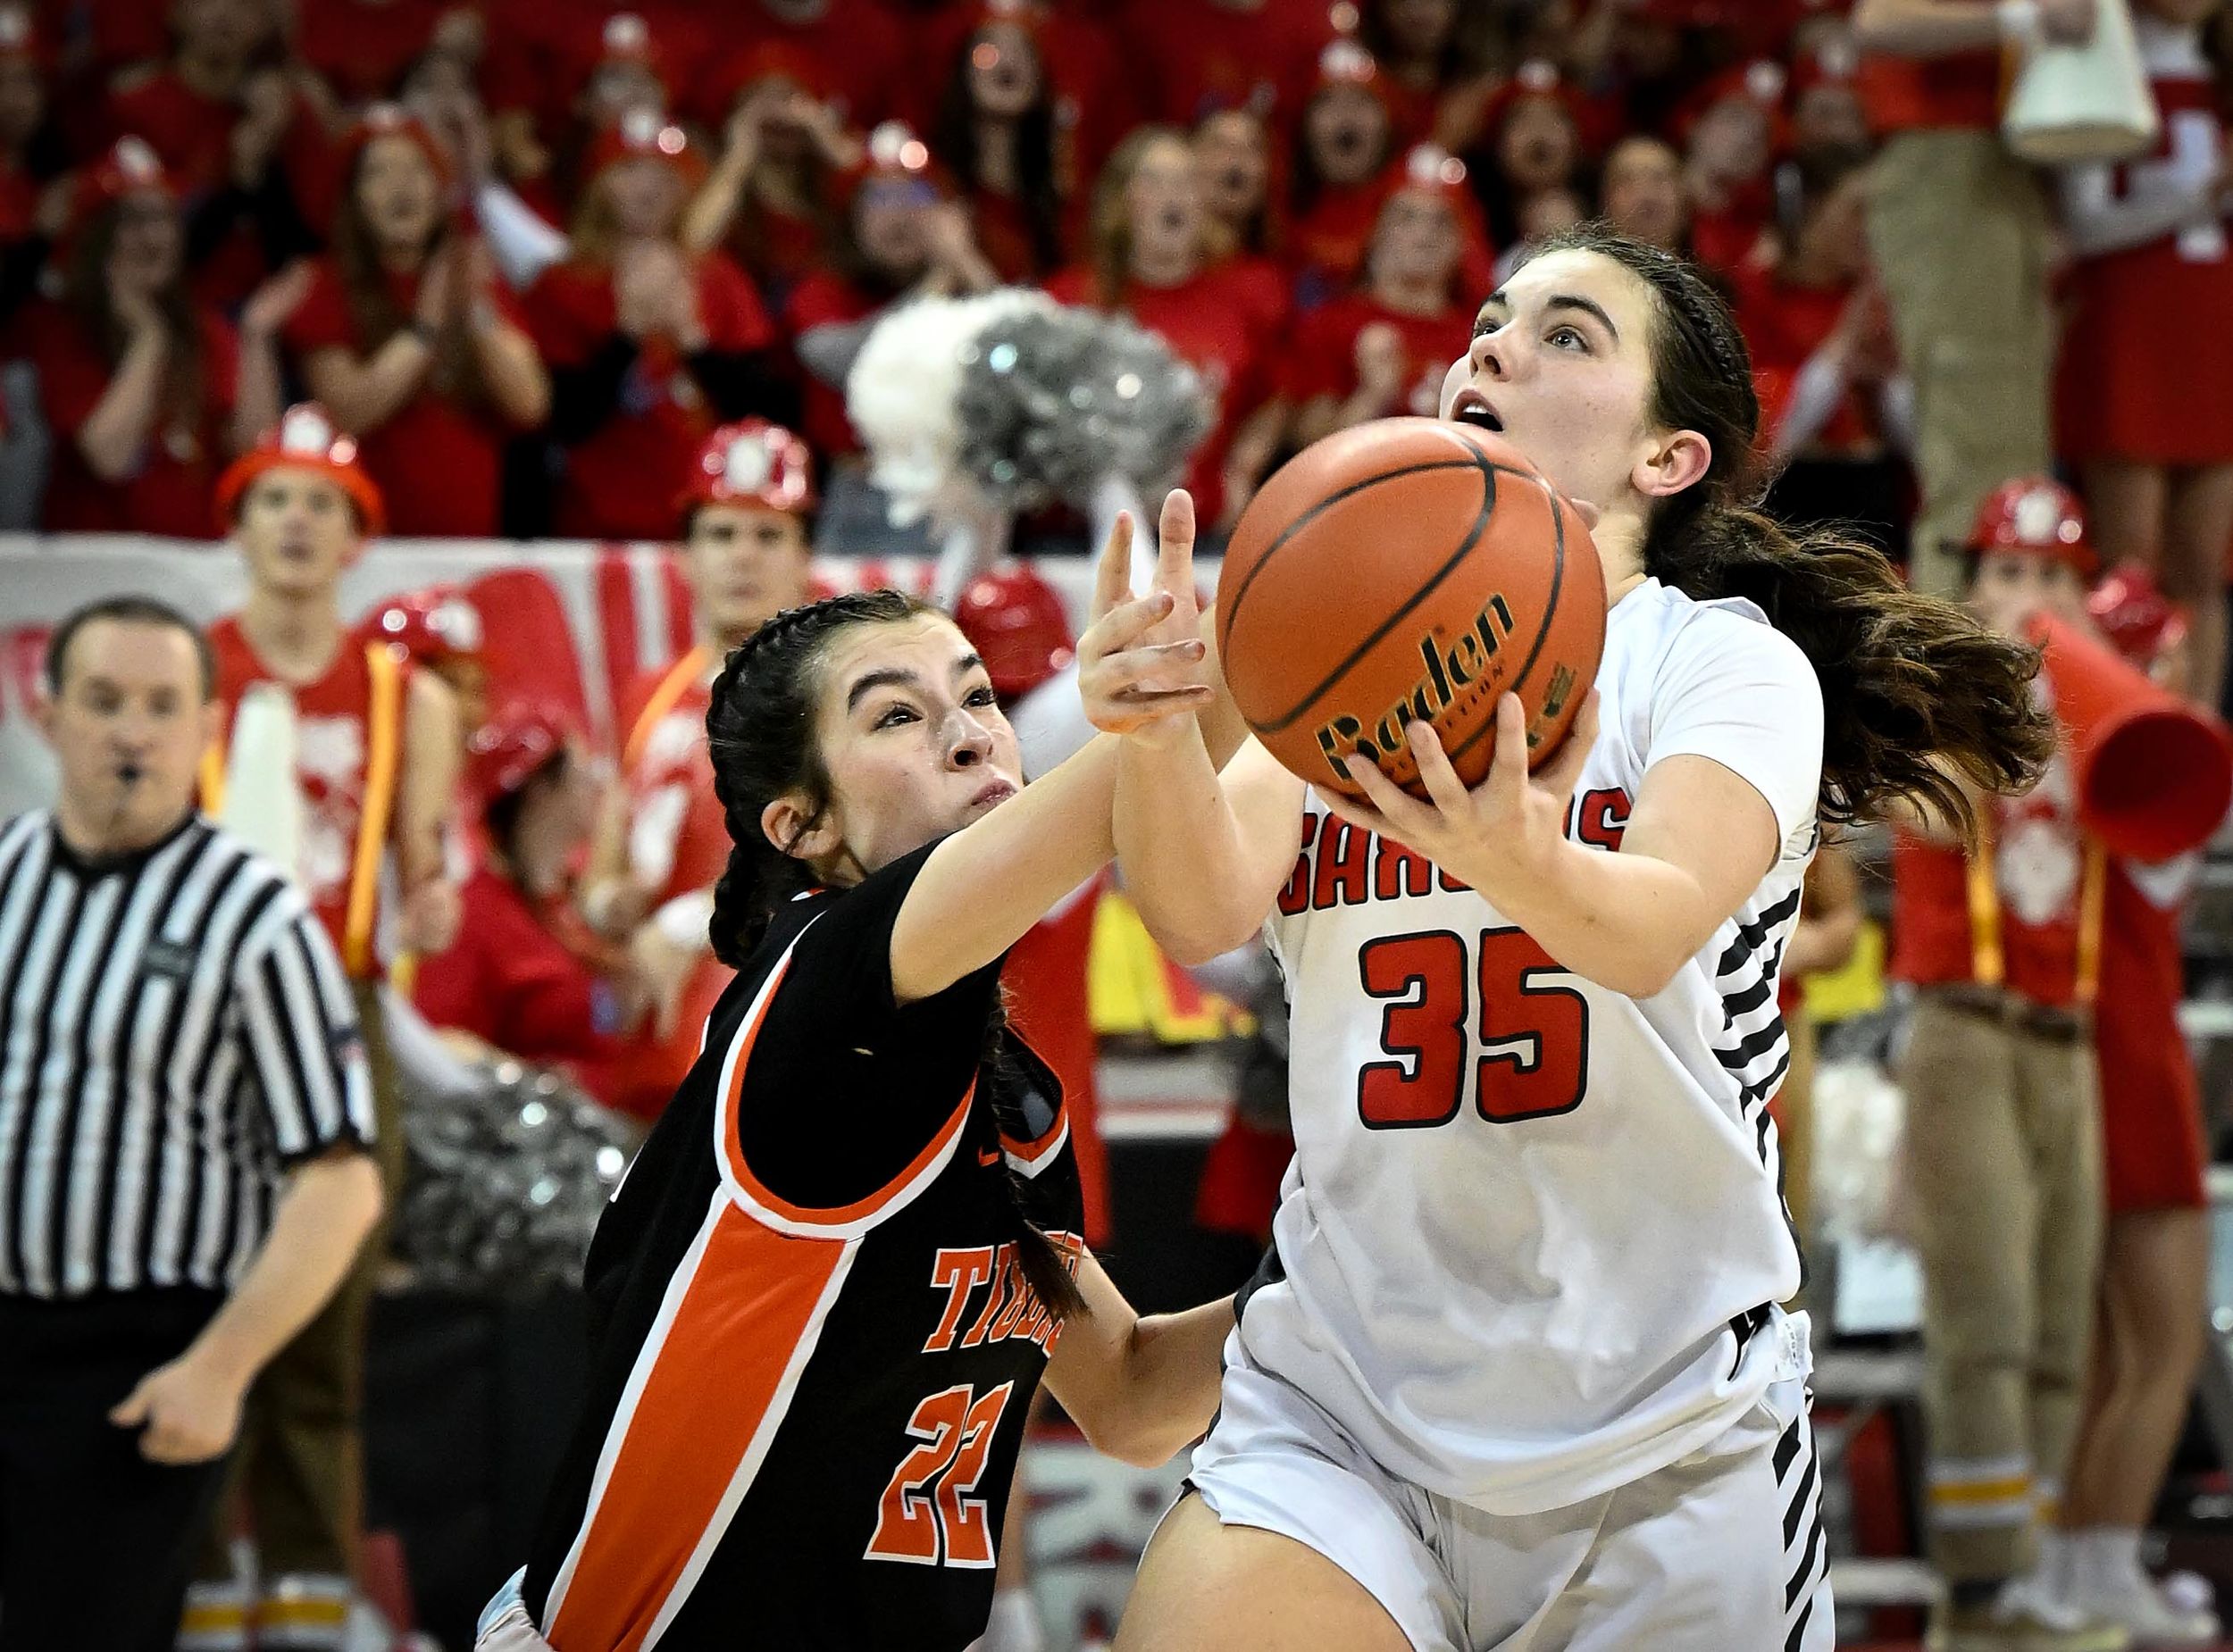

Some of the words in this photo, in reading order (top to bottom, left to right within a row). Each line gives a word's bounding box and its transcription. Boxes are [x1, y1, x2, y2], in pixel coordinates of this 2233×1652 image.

[1315, 593, 1515, 781] Baden
[1358, 926, 1590, 1131] 35
[863, 1380, 1015, 1569] 22
